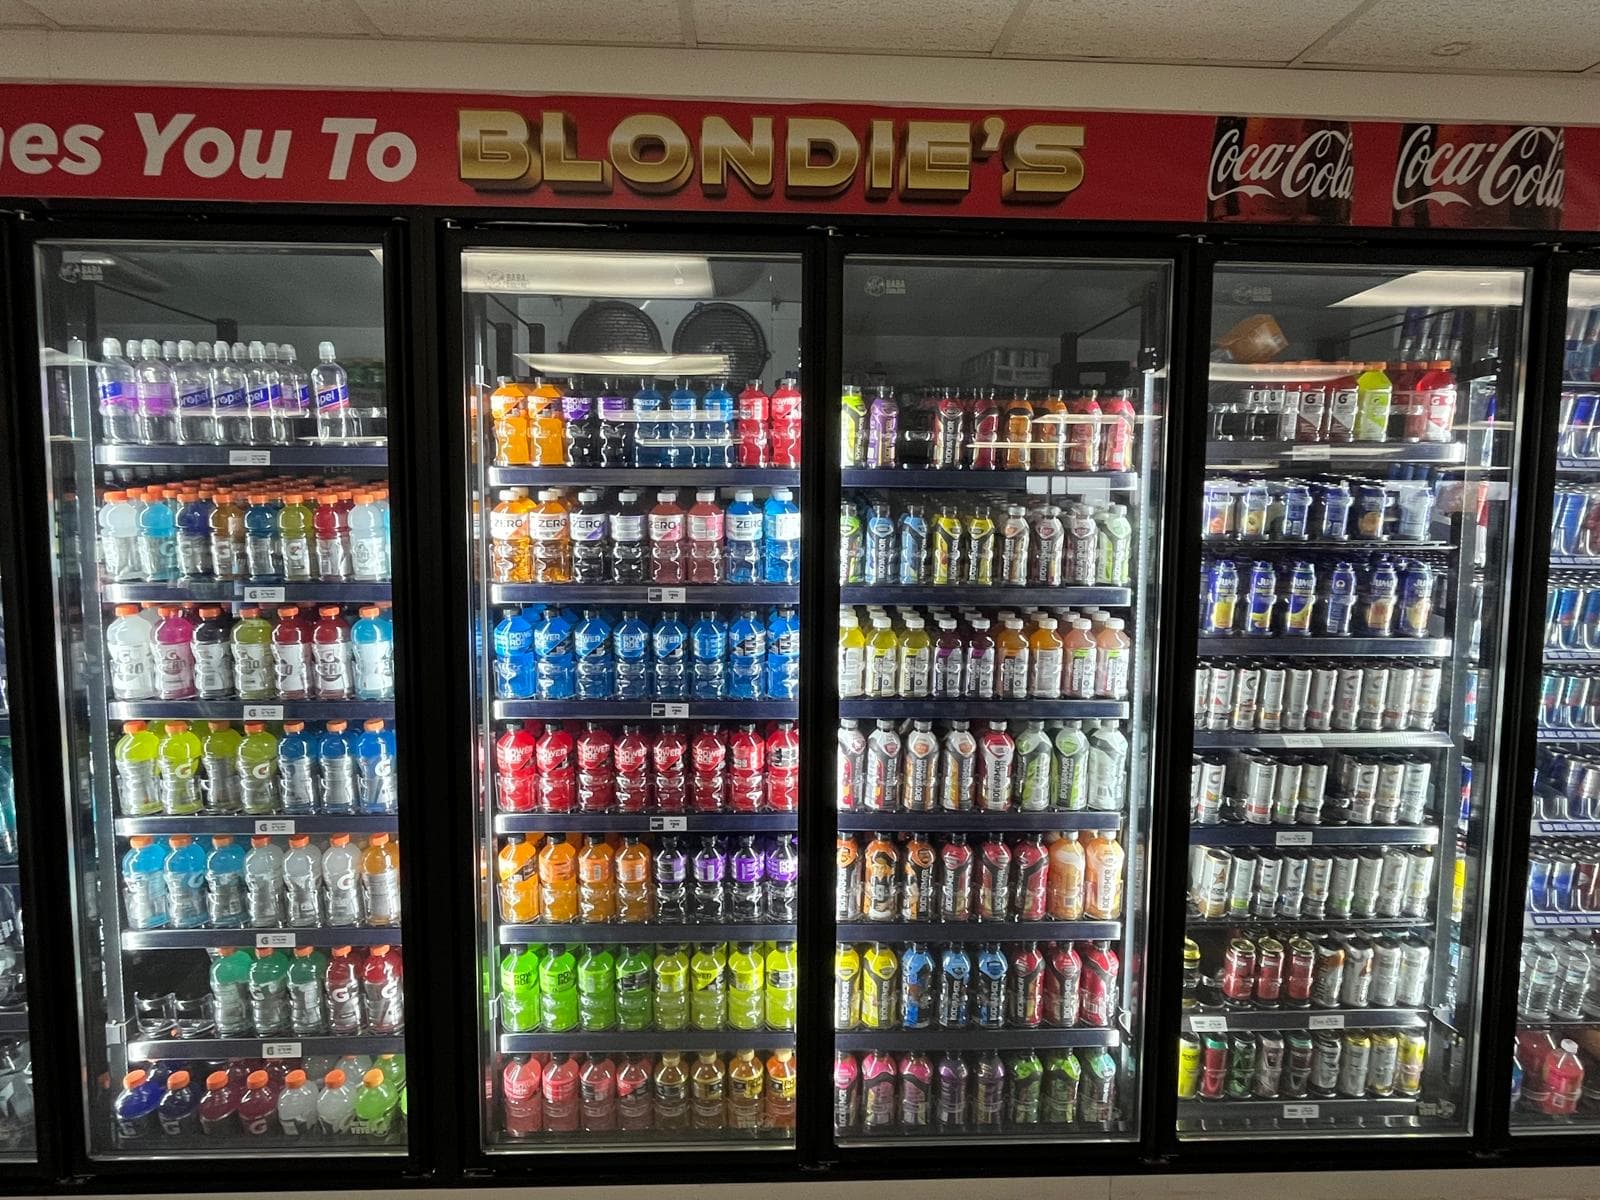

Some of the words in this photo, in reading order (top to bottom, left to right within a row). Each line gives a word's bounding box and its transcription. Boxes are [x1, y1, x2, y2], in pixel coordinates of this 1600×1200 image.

[0, 122, 105, 175] es
[132, 112, 292, 179] You
[320, 117, 417, 182] To
[458, 107, 1085, 207] BLONDIE'S
[1207, 128, 1354, 201] Coca-Cola
[1393, 124, 1564, 210] Coca-Cola
[213, 389, 244, 406] ropel
[1304, 393, 1317, 404] G
[1338, 393, 1349, 404] G
[944, 420, 956, 464] BODYARMOR
[494, 519, 523, 528] ZERO
[538, 518, 567, 528] ZERO
[572, 519, 602, 529] ZERO
[647, 520, 677, 529] ZERO
[735, 519, 762, 529] ZERO
[249, 590, 257, 599] G
[248, 709, 257, 717] G
[914, 759, 925, 801] BODYARMOR
[993, 760, 1002, 803] BODYARMOR
[1059, 757, 1069, 799] BODYARMOR
[259, 823, 268, 831] G
[919, 868, 930, 912] BODYARMOR
[261, 936, 269, 944] G
[331, 988, 350, 1003] G
[266, 1046, 274, 1055] G
[249, 1119, 268, 1135] G
